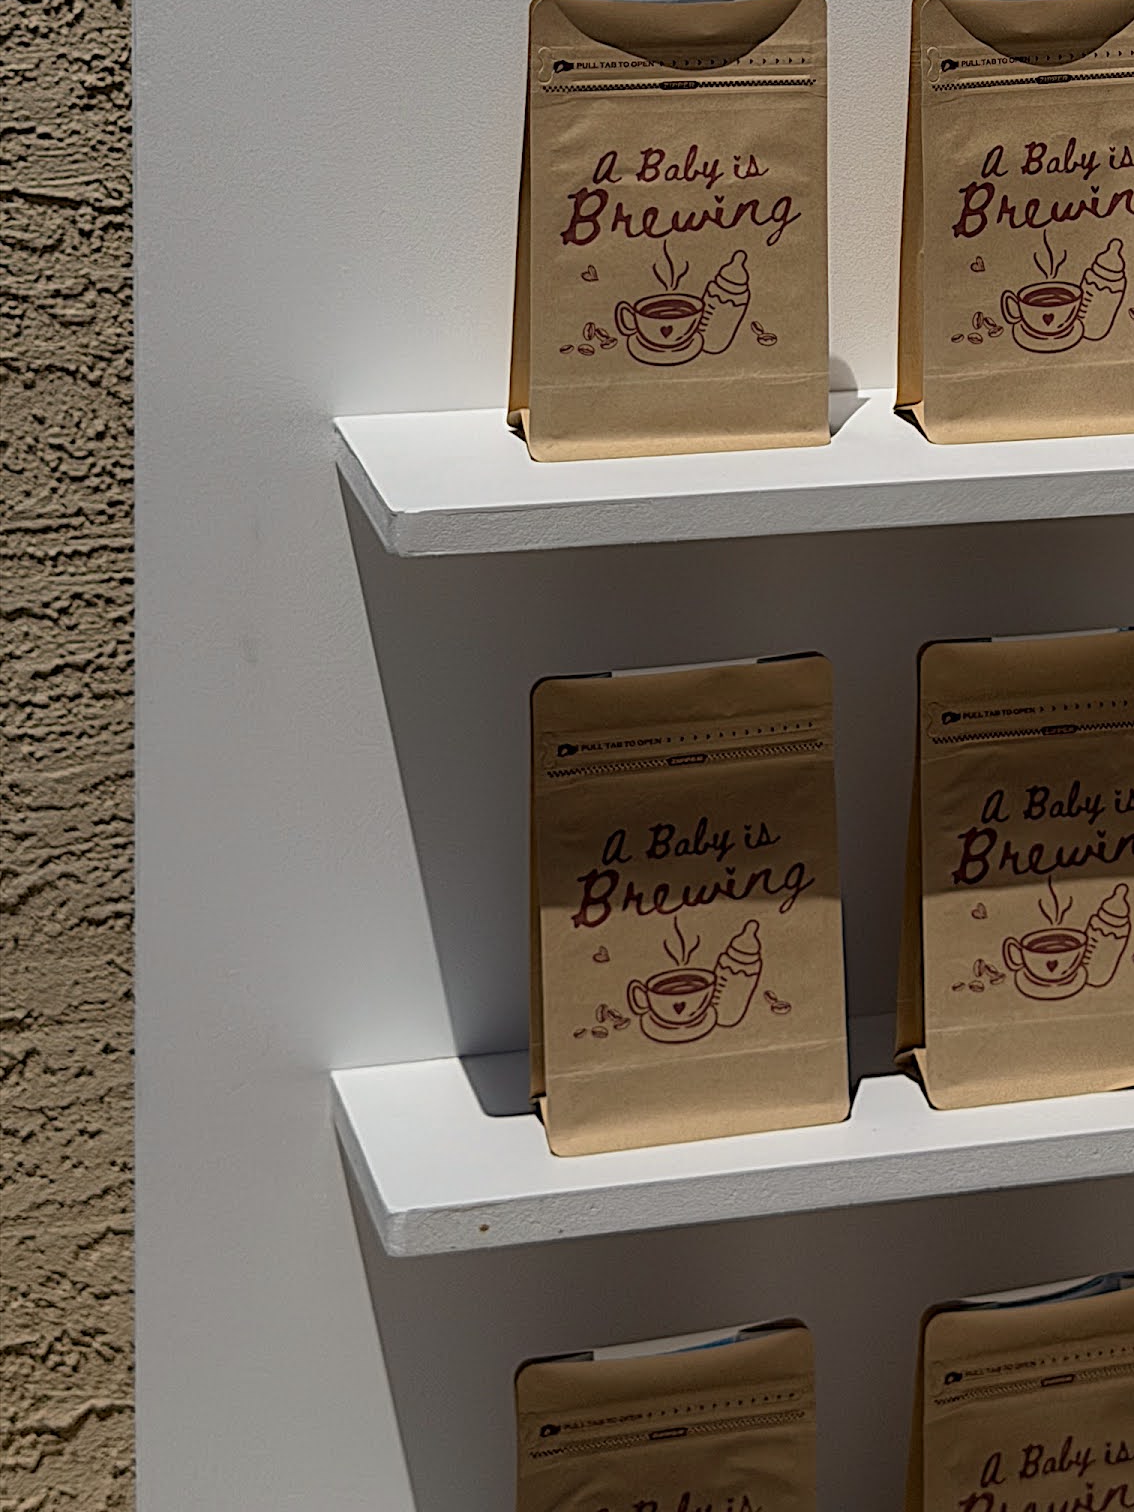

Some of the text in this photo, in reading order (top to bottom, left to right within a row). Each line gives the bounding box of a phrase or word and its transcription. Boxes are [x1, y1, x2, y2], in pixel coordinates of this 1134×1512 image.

[631, 60, 654, 68] OPEN
[980, 58, 997, 66] TAB
[591, 143, 769, 189] A Baby is
[980, 144, 1007, 179] A
[1020, 137, 1102, 180] Baby
[560, 187, 803, 247] Brewing
[637, 738, 662, 746] OPEN
[982, 789, 1008, 825] A
[1023, 781, 1107, 823] Baby
[601, 817, 781, 866] A Baby is
[571, 862, 814, 929] Brewing
[980, 1451, 1008, 1489] A
[1017, 1435, 1096, 1481] Baby
